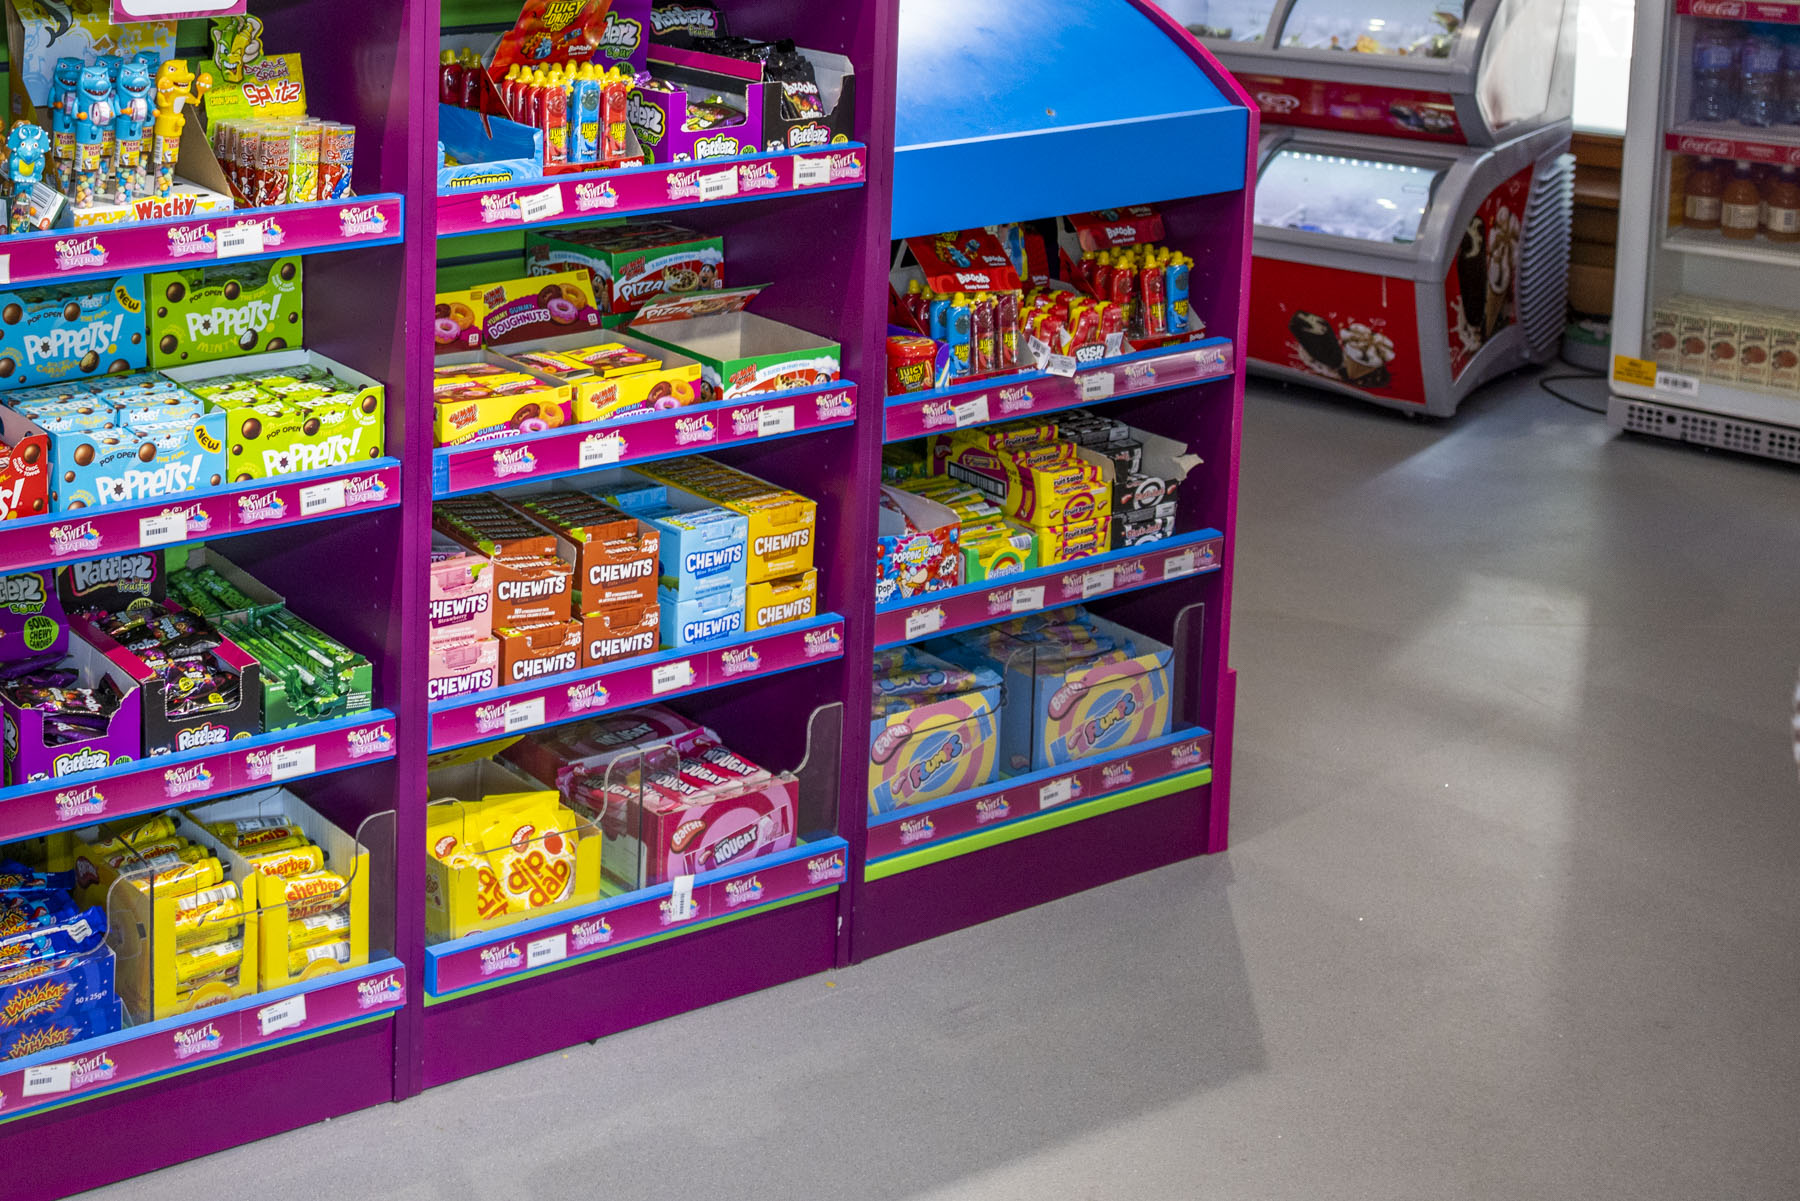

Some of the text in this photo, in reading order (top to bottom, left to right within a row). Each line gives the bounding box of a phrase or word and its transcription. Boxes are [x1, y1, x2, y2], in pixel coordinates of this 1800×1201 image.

[548, 0, 587, 16] JUICY
[547, 12, 574, 26] DROP
[135, 198, 195, 220] Wacky
[189, 289, 223, 303] POP OPEN
[621, 280, 664, 301] PIZZA
[116, 287, 140, 312] NEW
[27, 311, 62, 327] POP OPEN
[488, 303, 532, 327] YUMMY GUMMY
[488, 309, 551, 340] DOUGHNUTS
[1076, 345, 1105, 360] PUSH
[900, 366, 924, 378] JUICY
[902, 373, 922, 384] DROP
[282, 425, 303, 435] OPEN
[195, 426, 221, 451] NEW
[1005, 434, 1040, 446] Fruit Salad
[99, 451, 137, 467] POP OPEN
[1027, 452, 1060, 465] Fruit Salad
[1063, 503, 1096, 517] Fruit Salad
[1064, 525, 1097, 540] Fruit Salad
[646, 543, 658, 554] 40
[892, 544, 943, 563] POPPING CANDY
[74, 554, 153, 591] Rattlerz
[117, 579, 150, 596] fruity
[28, 616, 50, 631] SOUR
[30, 628, 53, 640] CHEWY
[29, 638, 52, 651] CANDIES
[704, 749, 758, 777] NOUGAT
[672, 820, 703, 847] Barratt
[714, 827, 758, 863] NOUGAT
[507, 849, 544, 894] dip
[529, 857, 569, 909] dab
[4, 986, 62, 1016] WHAM
[75, 995, 85, 1005] 50
